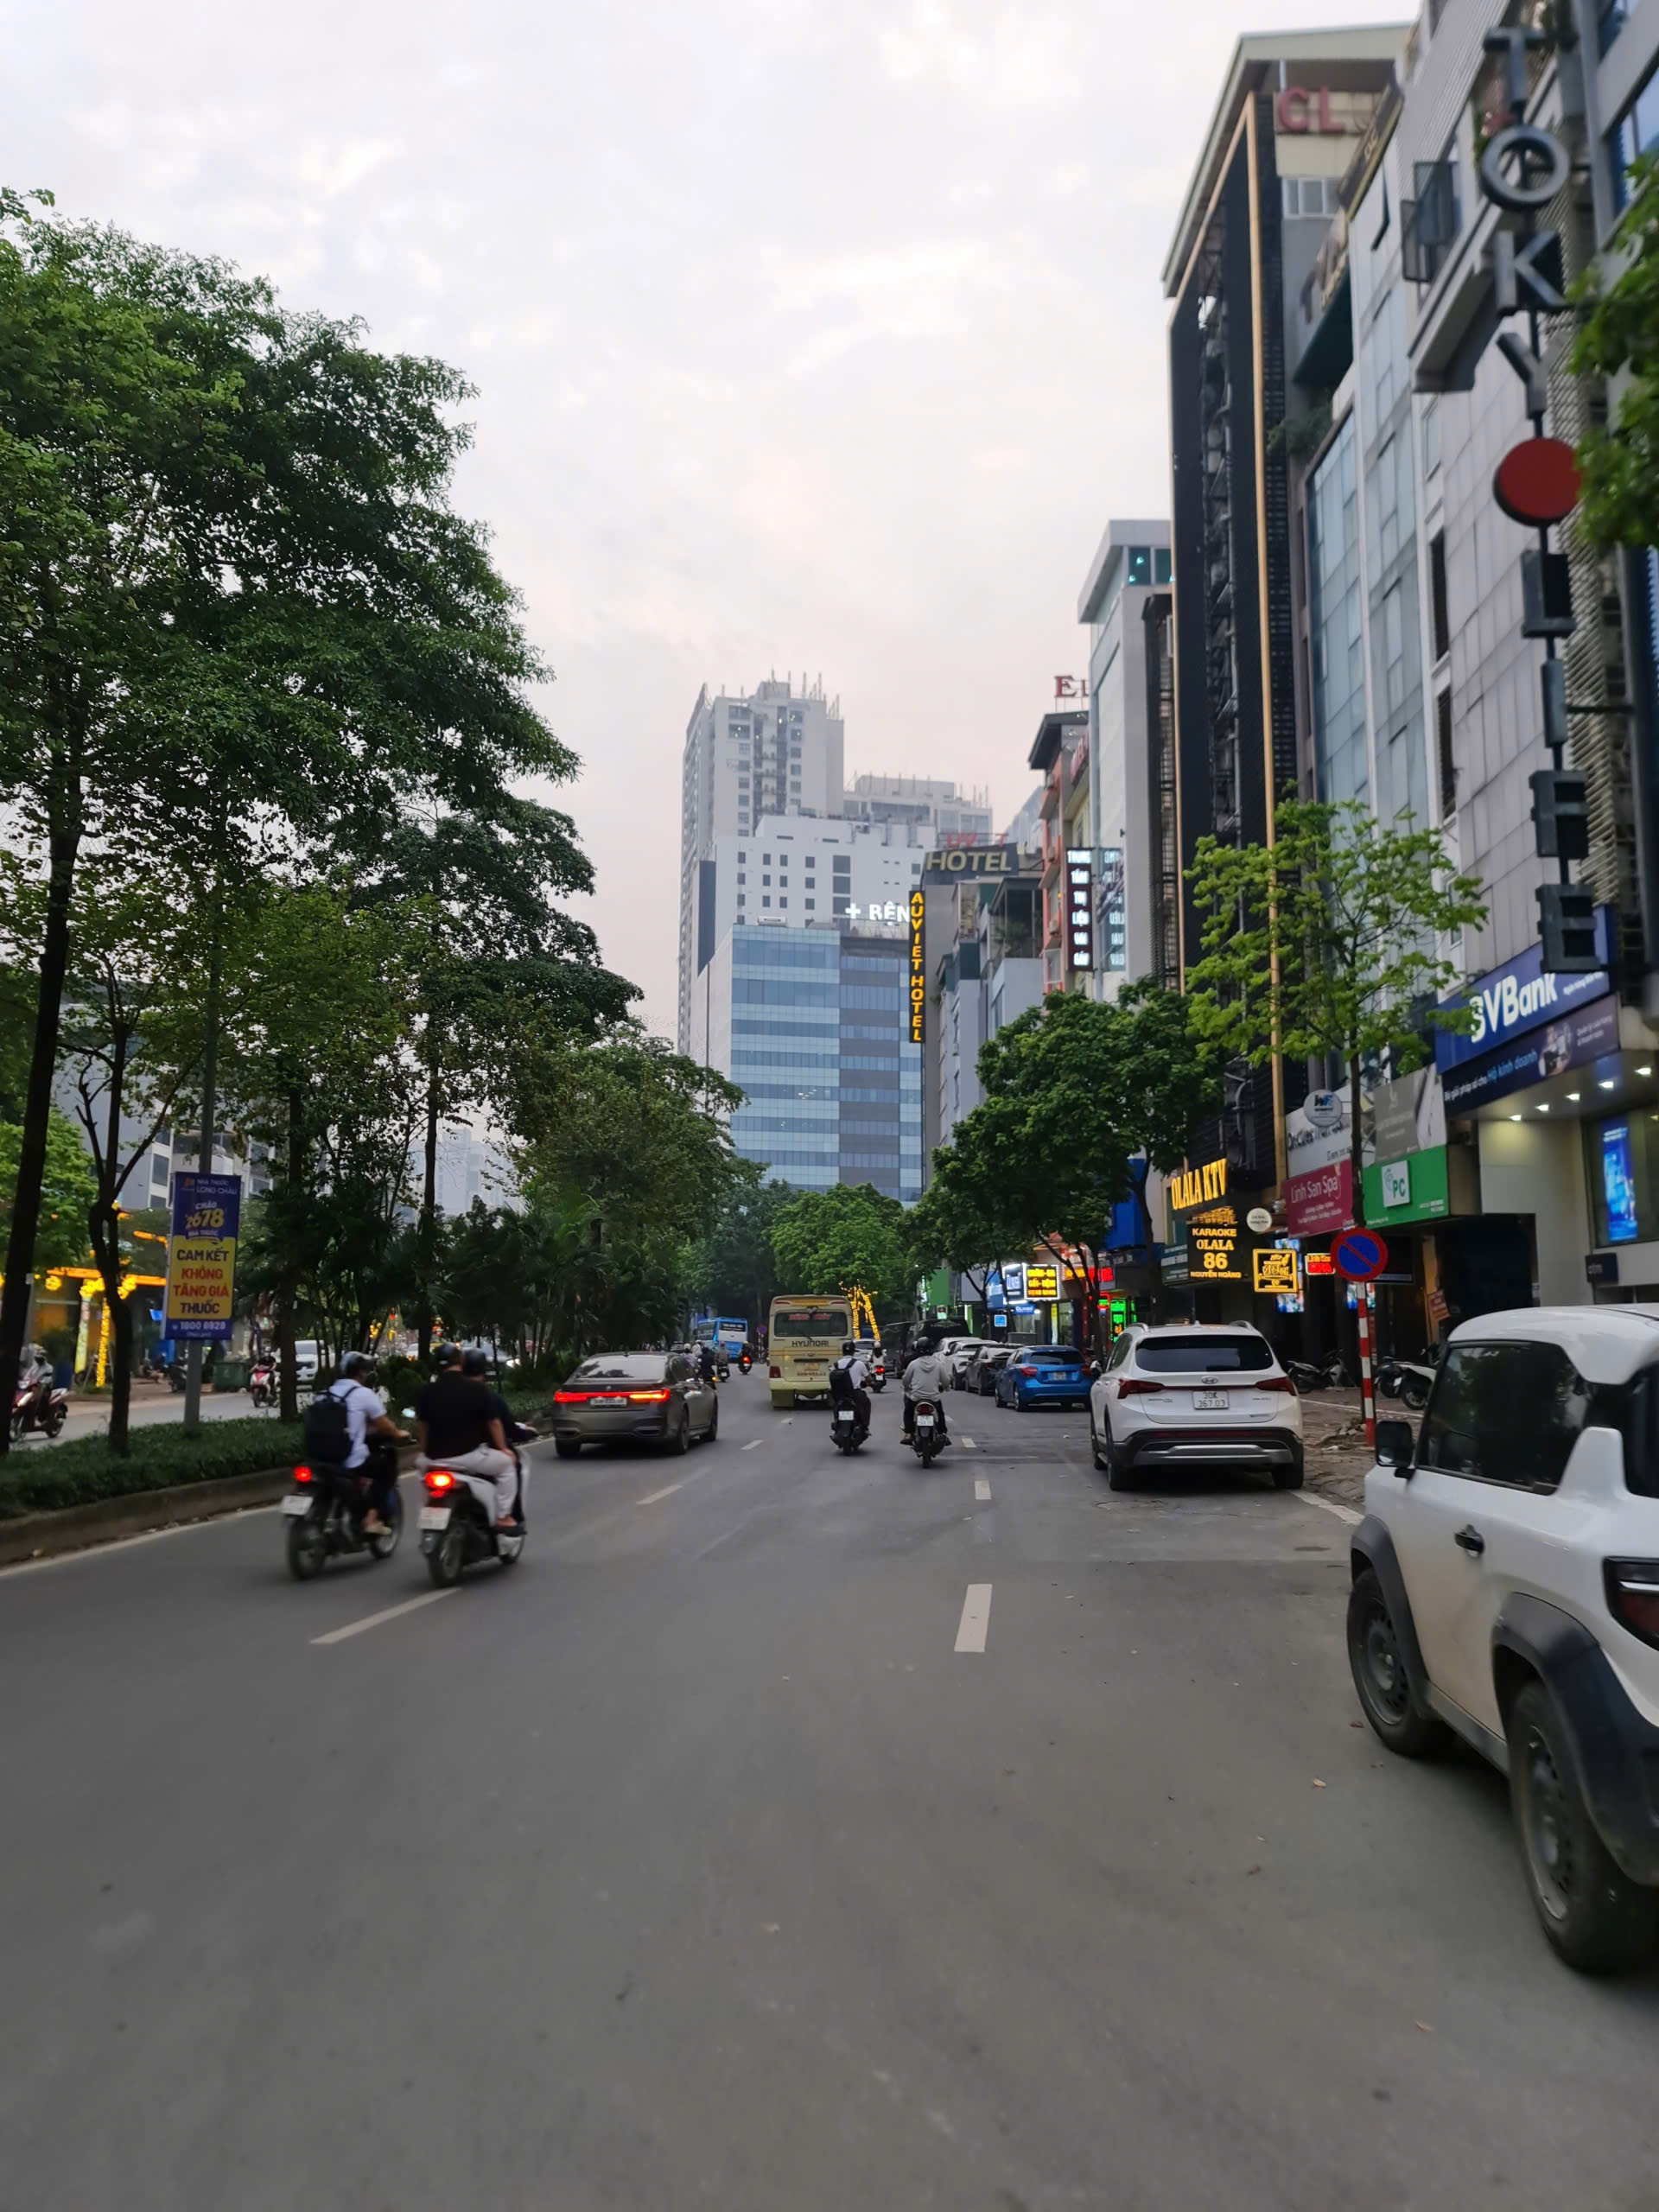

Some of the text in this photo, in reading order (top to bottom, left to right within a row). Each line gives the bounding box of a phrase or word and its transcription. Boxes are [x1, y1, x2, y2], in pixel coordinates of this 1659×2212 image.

[926, 850, 1012, 872] HOTEL
[911, 976, 924, 1041] HOTEL
[1171, 1158, 1226, 1210] OLALA KTV
[1306, 1180, 1323, 1198] San
[1322, 1174, 1338, 1198] Spa
[1392, 1179, 1406, 1198] PC
[1192, 1228, 1237, 1236] KARAOKE
[1196, 1239, 1235, 1251] OLALA
[176, 1246, 229, 1262] CAM KẾT
[1204, 1252, 1228, 1269] 86
[181, 1265, 224, 1280] KHÔNG
[173, 1283, 229, 1297] TĂNG GIÁ
[180, 1300, 220, 1314] THUỐC
